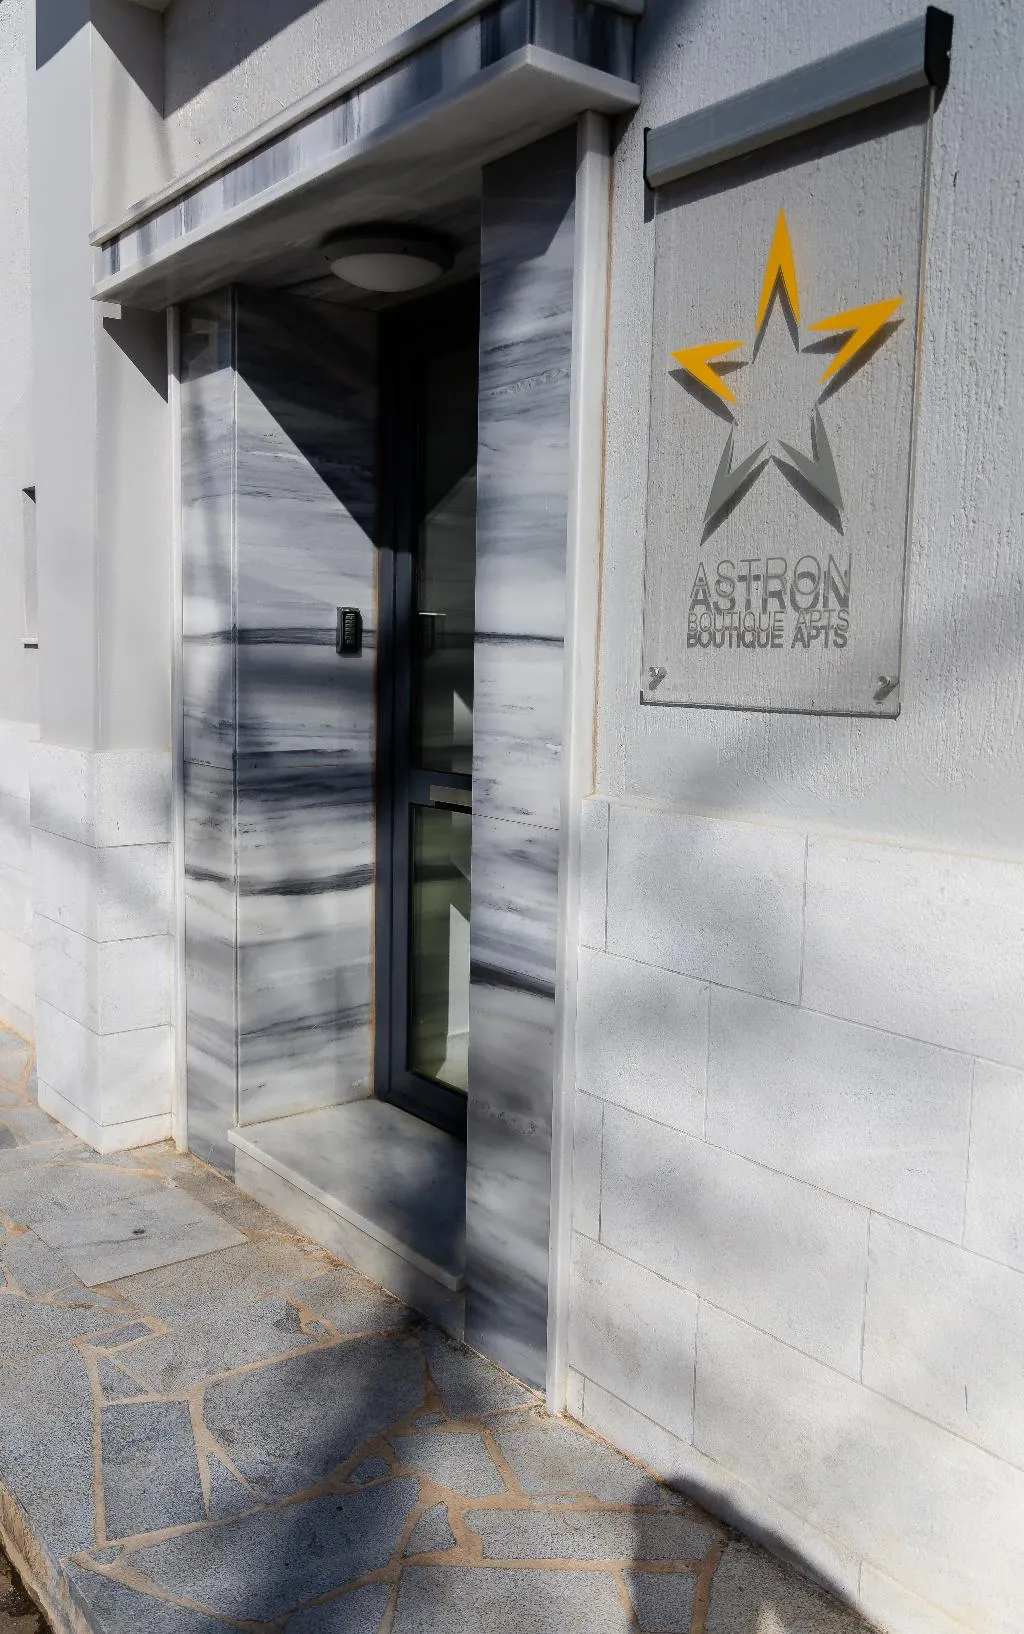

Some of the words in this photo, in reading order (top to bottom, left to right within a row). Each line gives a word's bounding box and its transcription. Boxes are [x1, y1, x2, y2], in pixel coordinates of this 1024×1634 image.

[688, 553, 853, 609] ASTRON
[687, 610, 786, 633] BOUTIQUE
[796, 608, 850, 633] APTS
